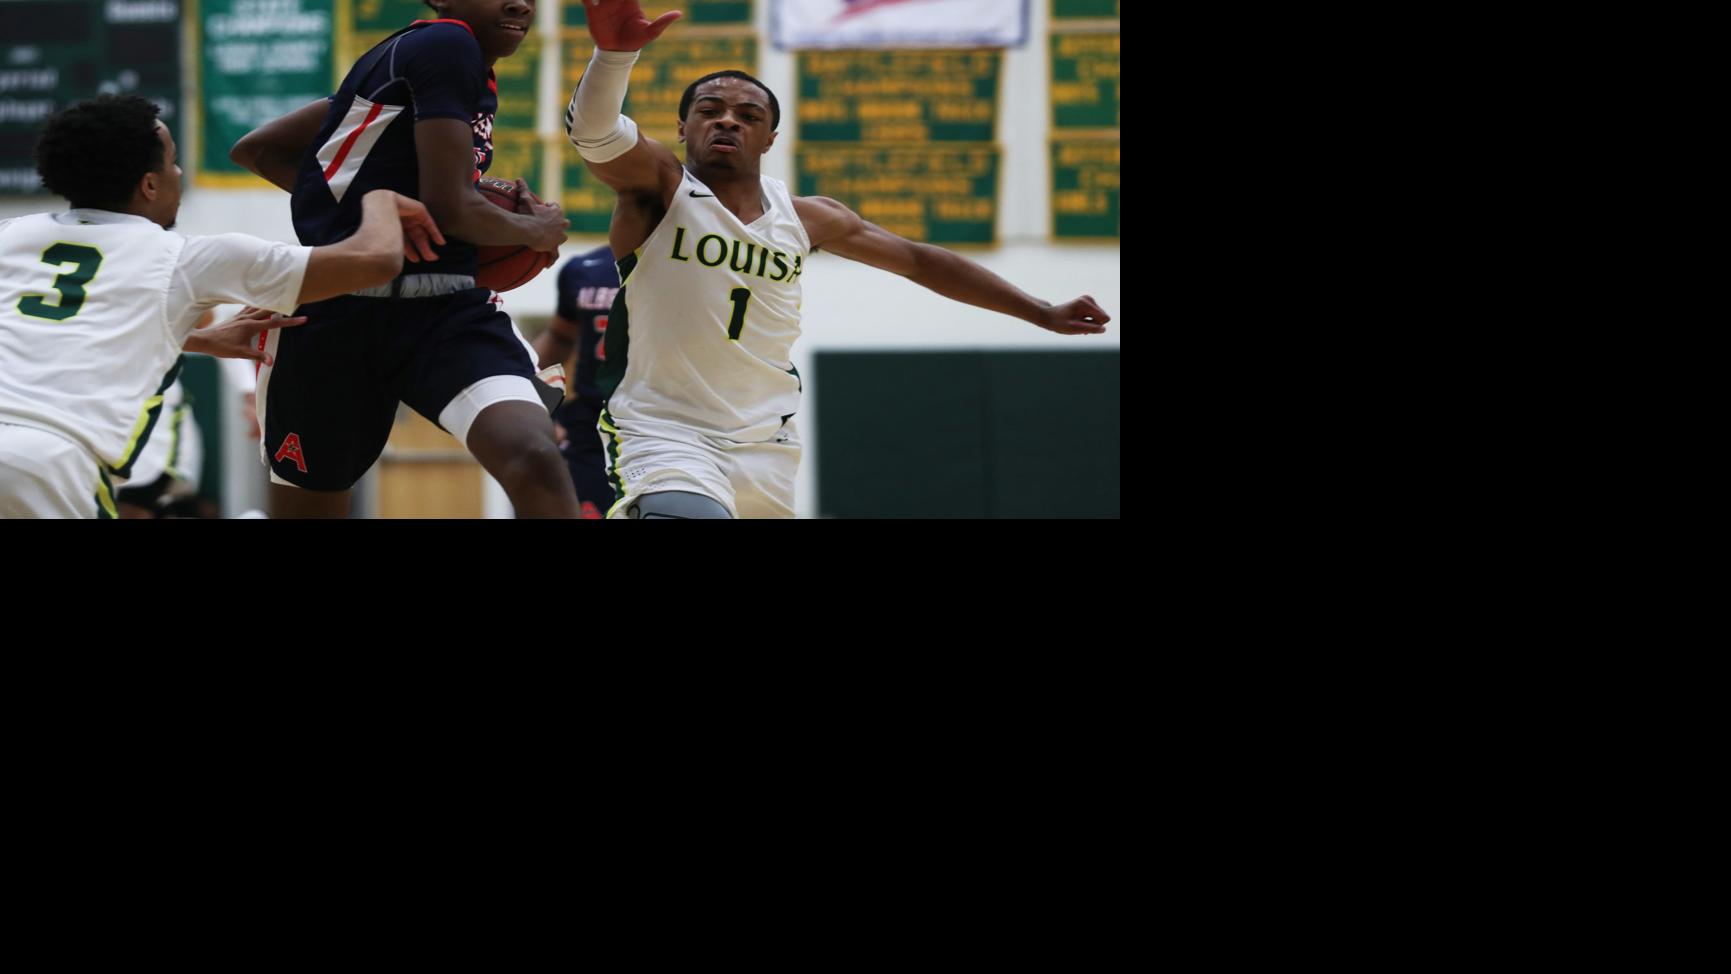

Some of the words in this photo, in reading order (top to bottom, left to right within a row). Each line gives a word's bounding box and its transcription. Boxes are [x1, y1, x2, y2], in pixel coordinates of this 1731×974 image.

[17, 241, 104, 321] 3
[727, 286, 752, 342] 1
[274, 432, 308, 473] A
